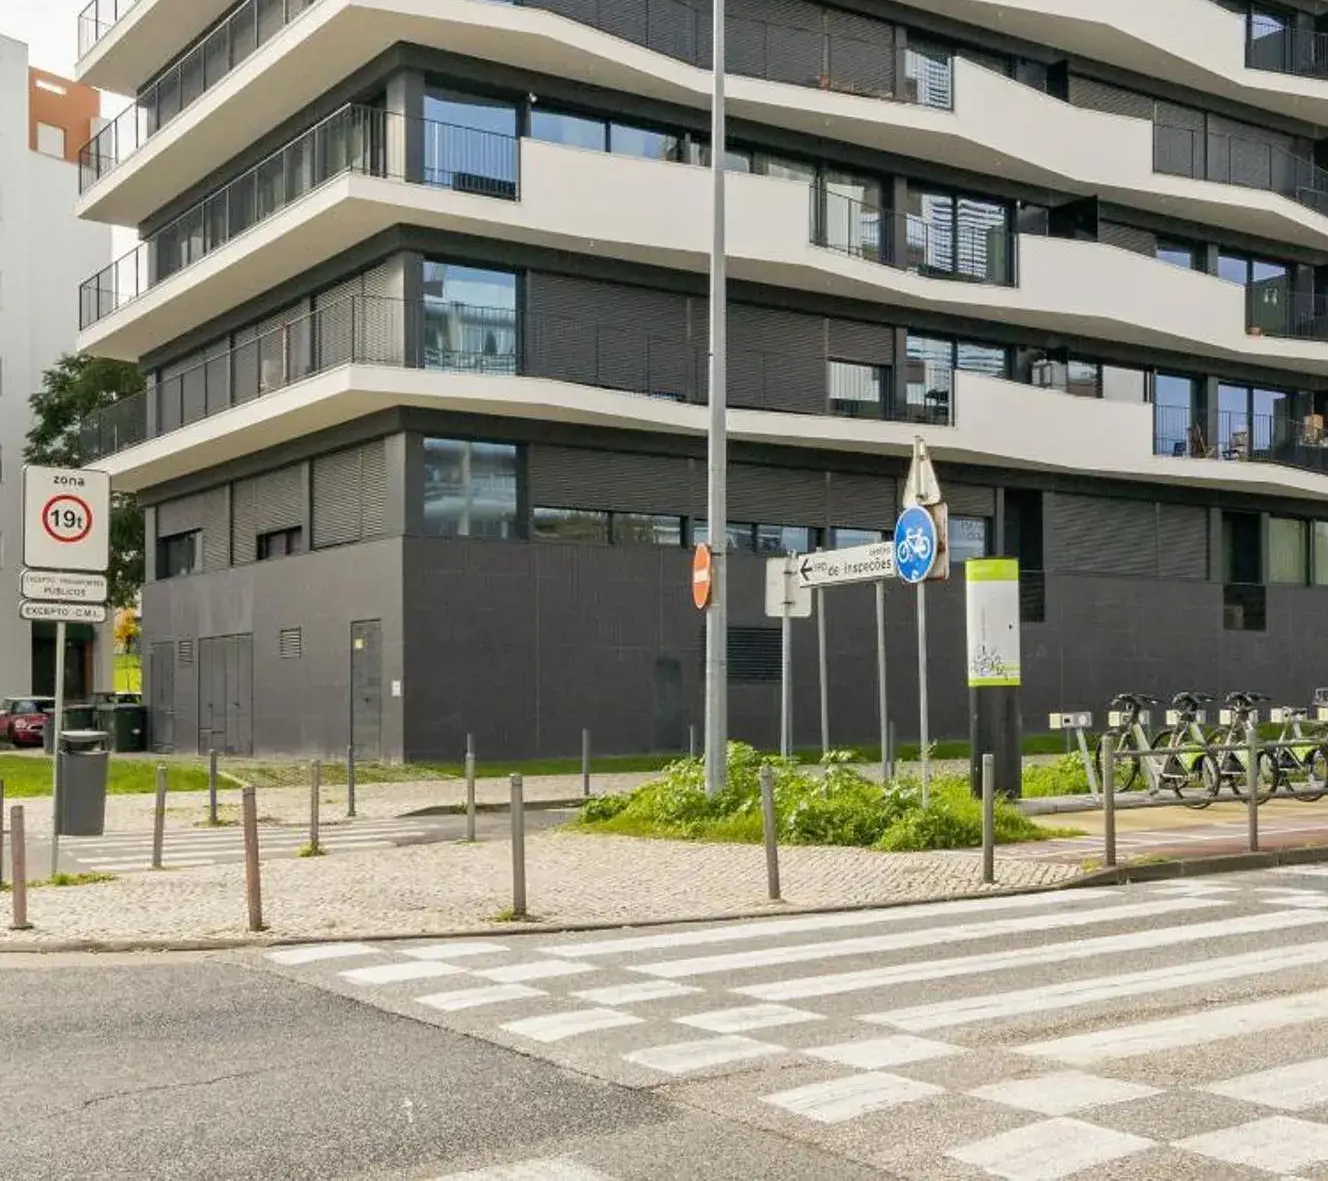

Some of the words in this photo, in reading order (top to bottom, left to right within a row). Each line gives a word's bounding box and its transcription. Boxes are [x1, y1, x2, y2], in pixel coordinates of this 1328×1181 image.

[53, 475, 85, 487] zona
[51, 509, 82, 529] 19t
[828, 564, 839, 576] de
[844, 557, 891, 574] inspeções
[25, 605, 69, 617] EXCEPTO
